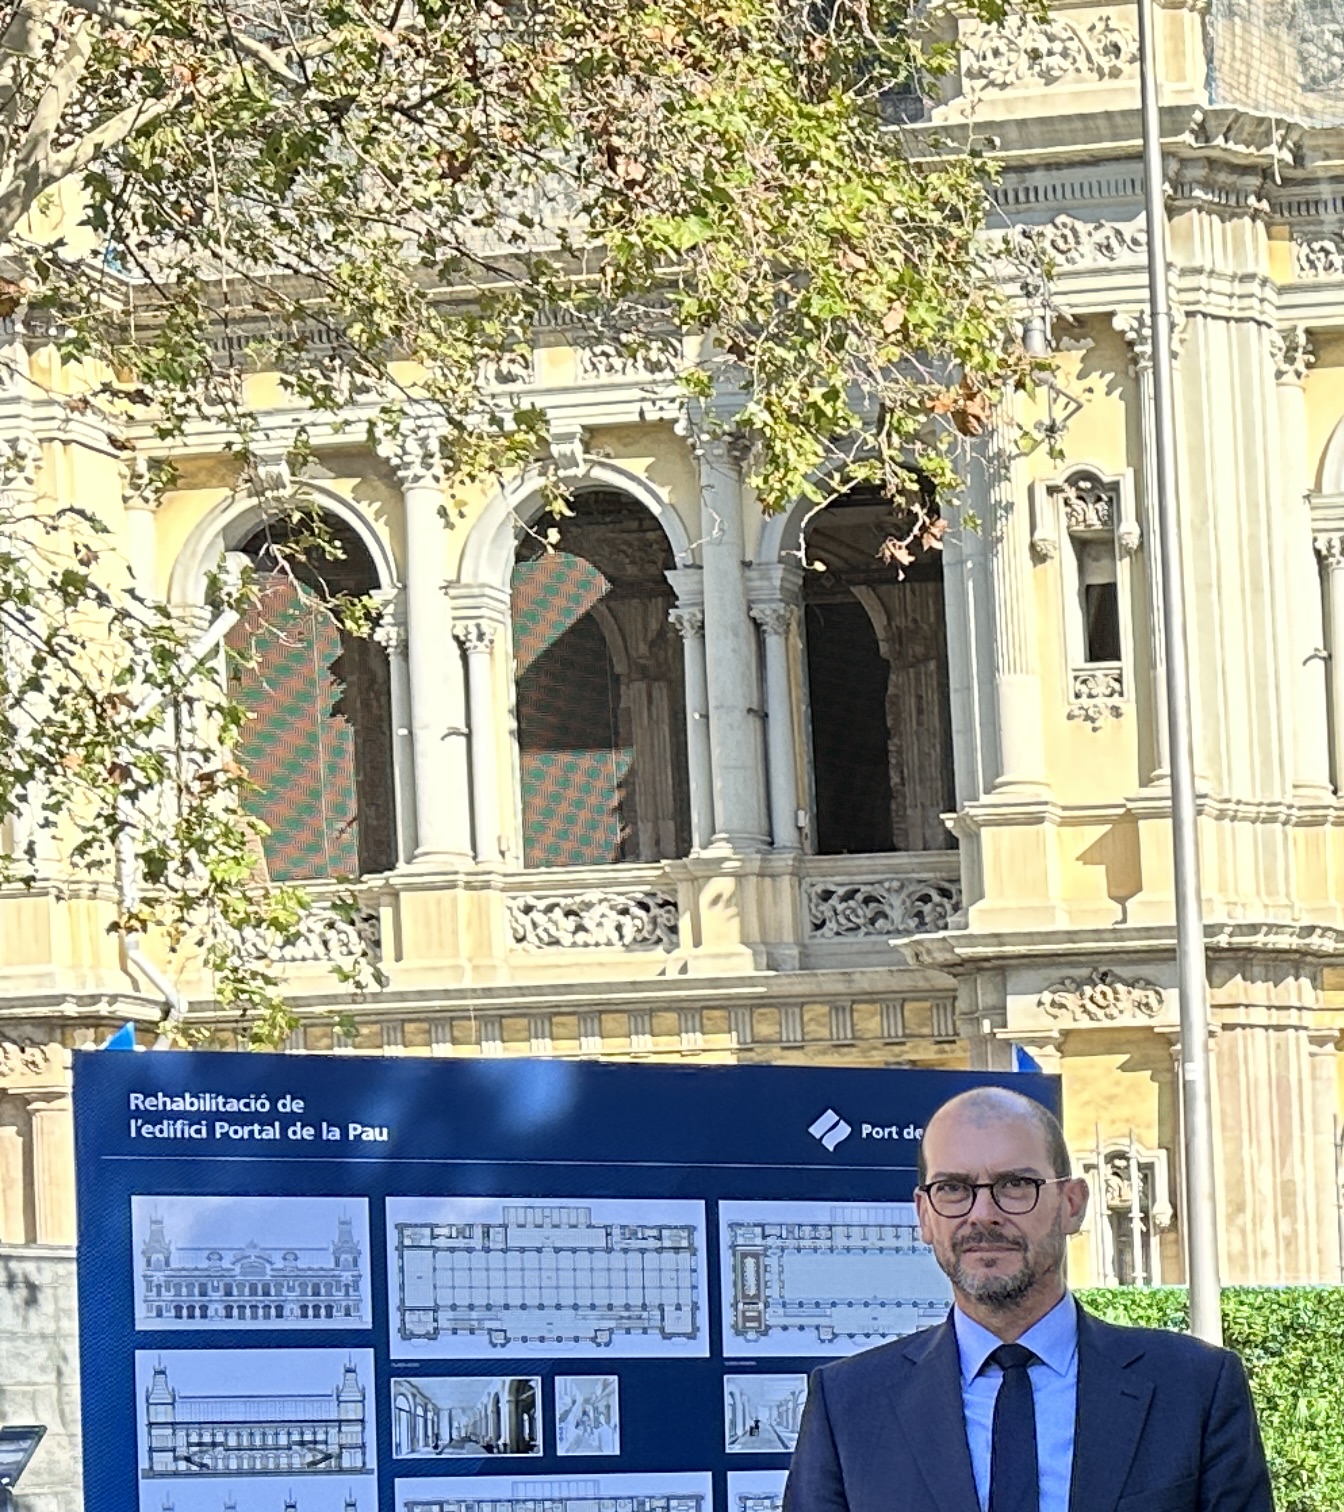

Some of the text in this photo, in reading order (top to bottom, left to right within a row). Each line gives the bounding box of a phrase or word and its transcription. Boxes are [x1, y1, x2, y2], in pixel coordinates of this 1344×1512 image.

[129, 1092, 305, 1113] Rehabilitació de
[129, 1118, 389, 1142] l'edifici Portal de la Pau
[861, 1123, 899, 1139] Port
